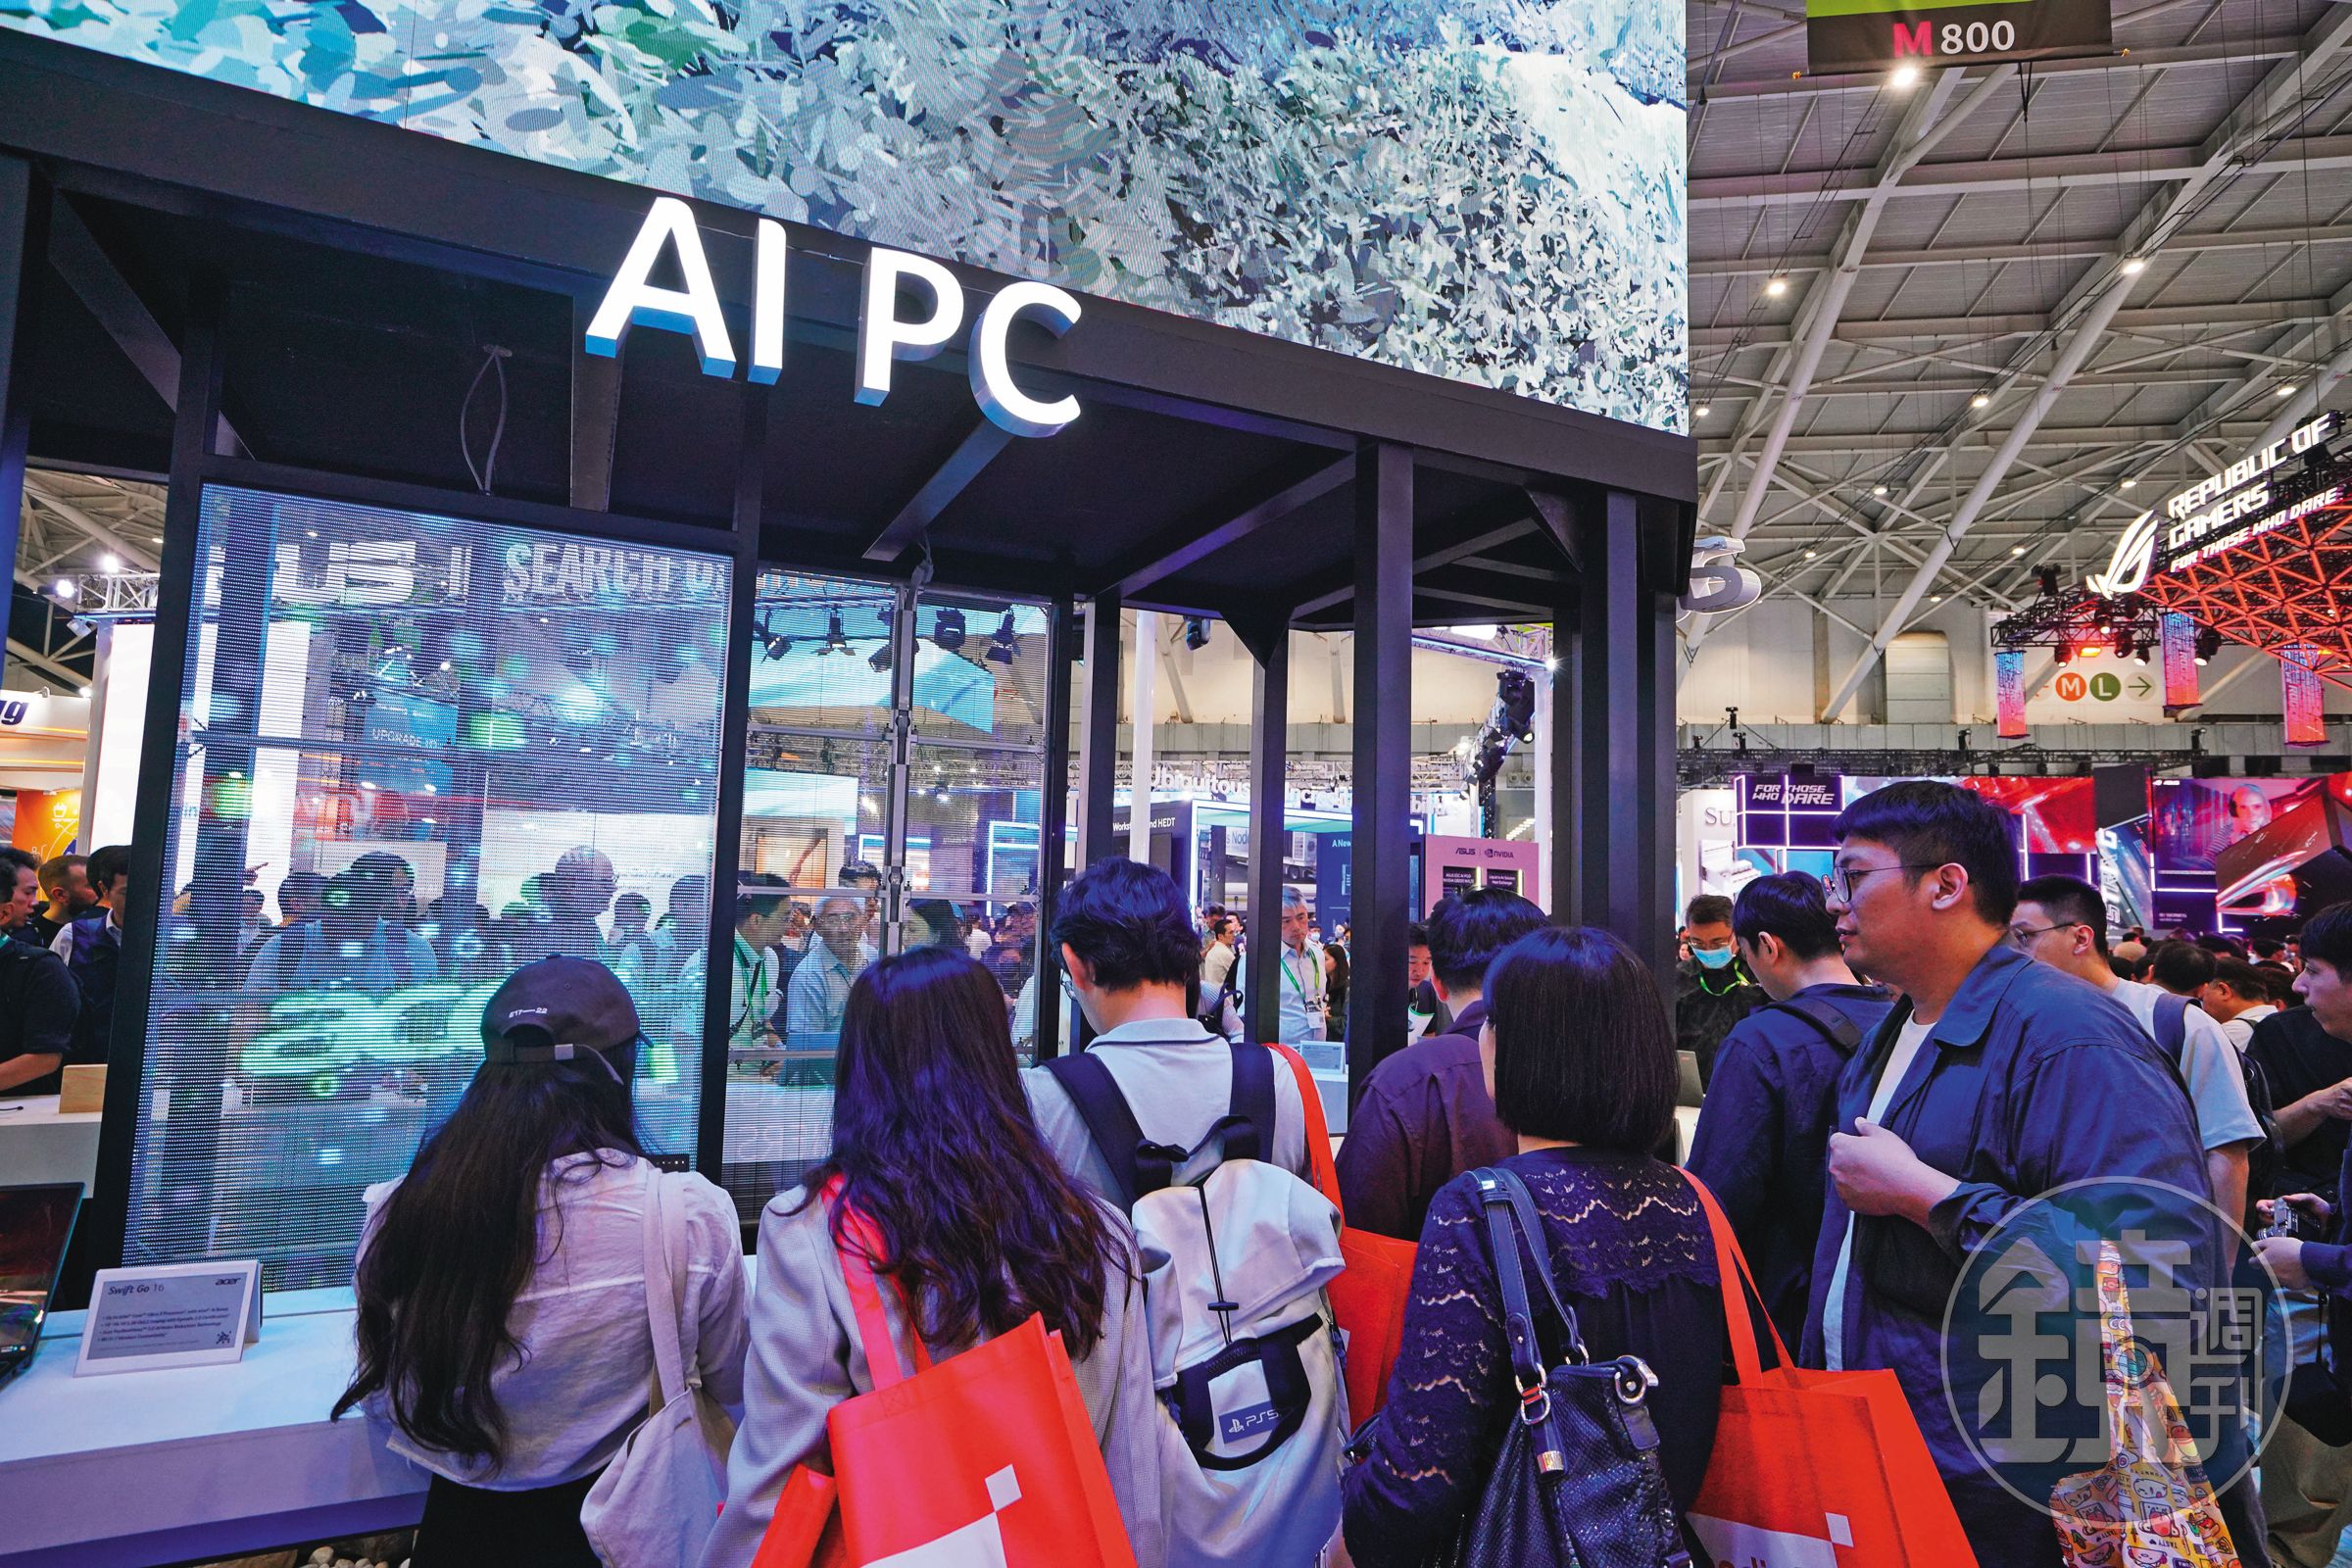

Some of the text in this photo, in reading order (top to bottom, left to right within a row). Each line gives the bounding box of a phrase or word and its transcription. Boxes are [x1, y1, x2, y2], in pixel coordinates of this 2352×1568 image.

[1892, 20, 2016, 59] M 800
[585, 196, 1082, 437] AI PC
[2168, 413, 2332, 520] REPUBLIC OF
[2169, 481, 2271, 551] GAMERS
[2170, 486, 2338, 573] FOR THOSE WHO DARE
[1754, 784, 1827, 794] FOR THOSE
[1752, 792, 1836, 806] WHO DARE
[1455, 847, 1476, 856] ASUS
[108, 1283, 165, 1296] Swift Go 16
[215, 1277, 241, 1286] acer
[1245, 1408, 1280, 1427] PS5
[2158, 1539, 2179, 1549] TASTY
